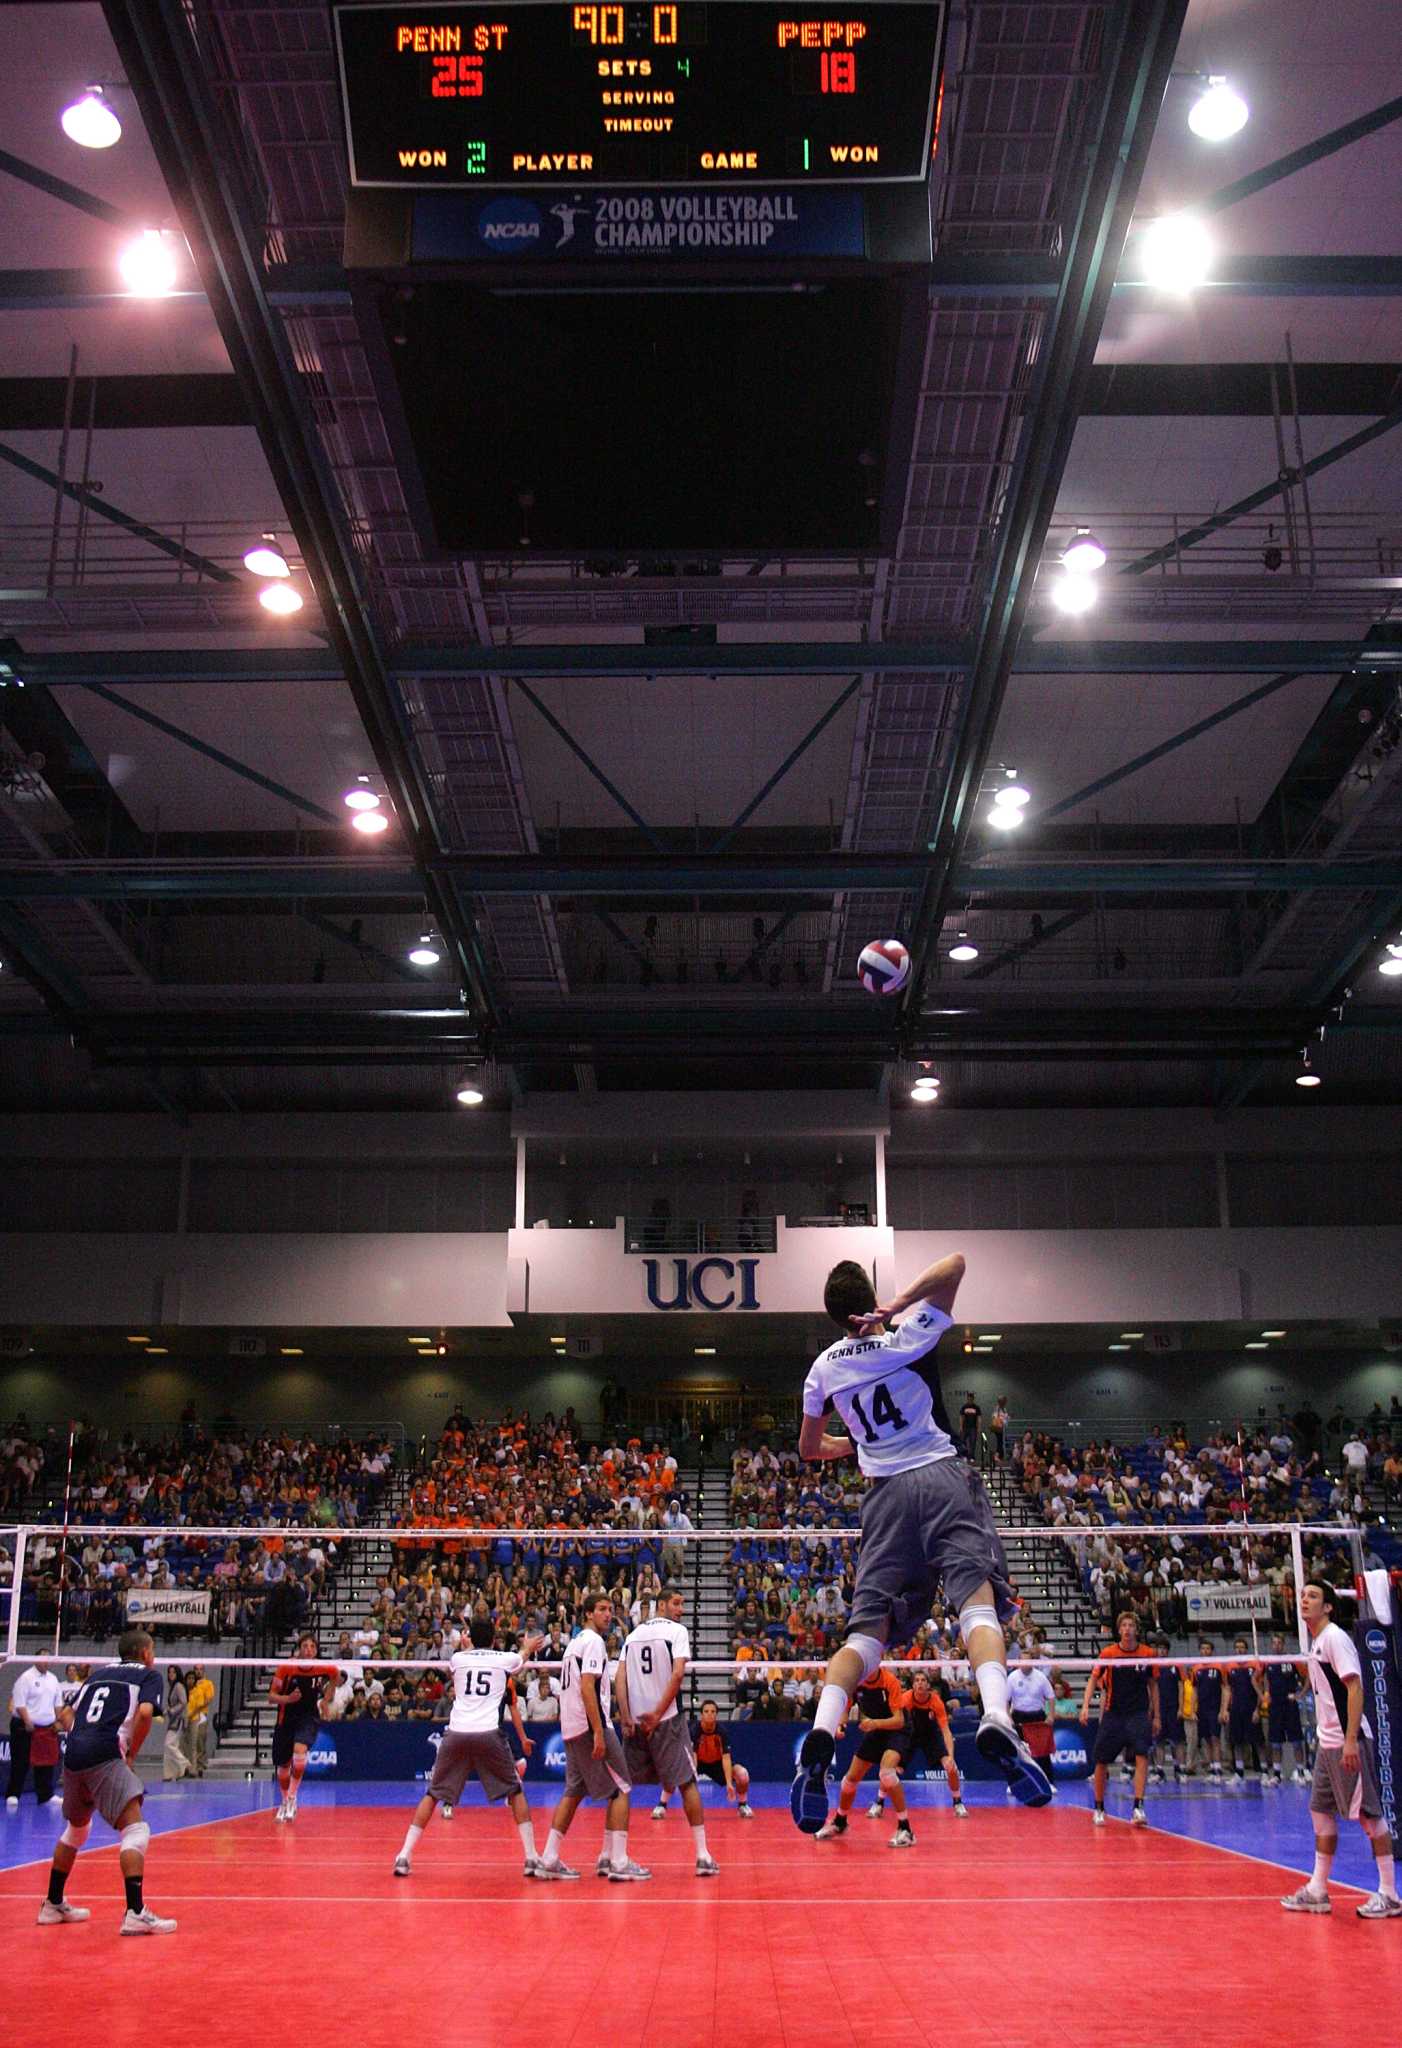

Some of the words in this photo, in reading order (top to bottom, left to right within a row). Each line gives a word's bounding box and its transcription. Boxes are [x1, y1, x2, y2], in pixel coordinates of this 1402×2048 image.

[398, 26, 461, 52] PENN
[474, 25, 508, 51] ST
[778, 22, 866, 48] PEPP
[432, 56, 483, 97] 25
[598, 60, 651, 76] SETS
[678, 58, 690, 78] 4
[821, 52, 855, 93] 18
[602, 91, 674, 105] SERVING
[604, 119, 673, 132] TIMEOUT
[399, 151, 447, 167] WON
[467, 142, 486, 174] 2
[513, 155, 593, 171] PLAYER
[701, 153, 758, 169] GAME
[804, 138, 809, 170] 1
[830, 147, 878, 162] WON
[595, 198, 654, 222] 2008
[660, 196, 798, 221] VOLLEYBALL
[484, 223, 540, 239] NCAA
[594, 222, 775, 247] CHAMPIONSHIP
[641, 1258, 761, 1311] UCI
[827, 1347, 853, 1361] PENN
[856, 1341, 888, 1355] STAT
[852, 1384, 909, 1443] 14
[153, 1601, 206, 1614] VOLLEYBALL
[1214, 1597, 1268, 1610] VOLLEYBALL
[641, 1646, 652, 1674] 9
[464, 1670, 492, 1696] 15
[86, 1687, 110, 1723] 6
[304, 1751, 337, 1765] CAA
[545, 1752, 567, 1765] NC
[1049, 1749, 1087, 1764] NCAA
[1371, 1660, 1399, 1840] VOLLEYBALL
